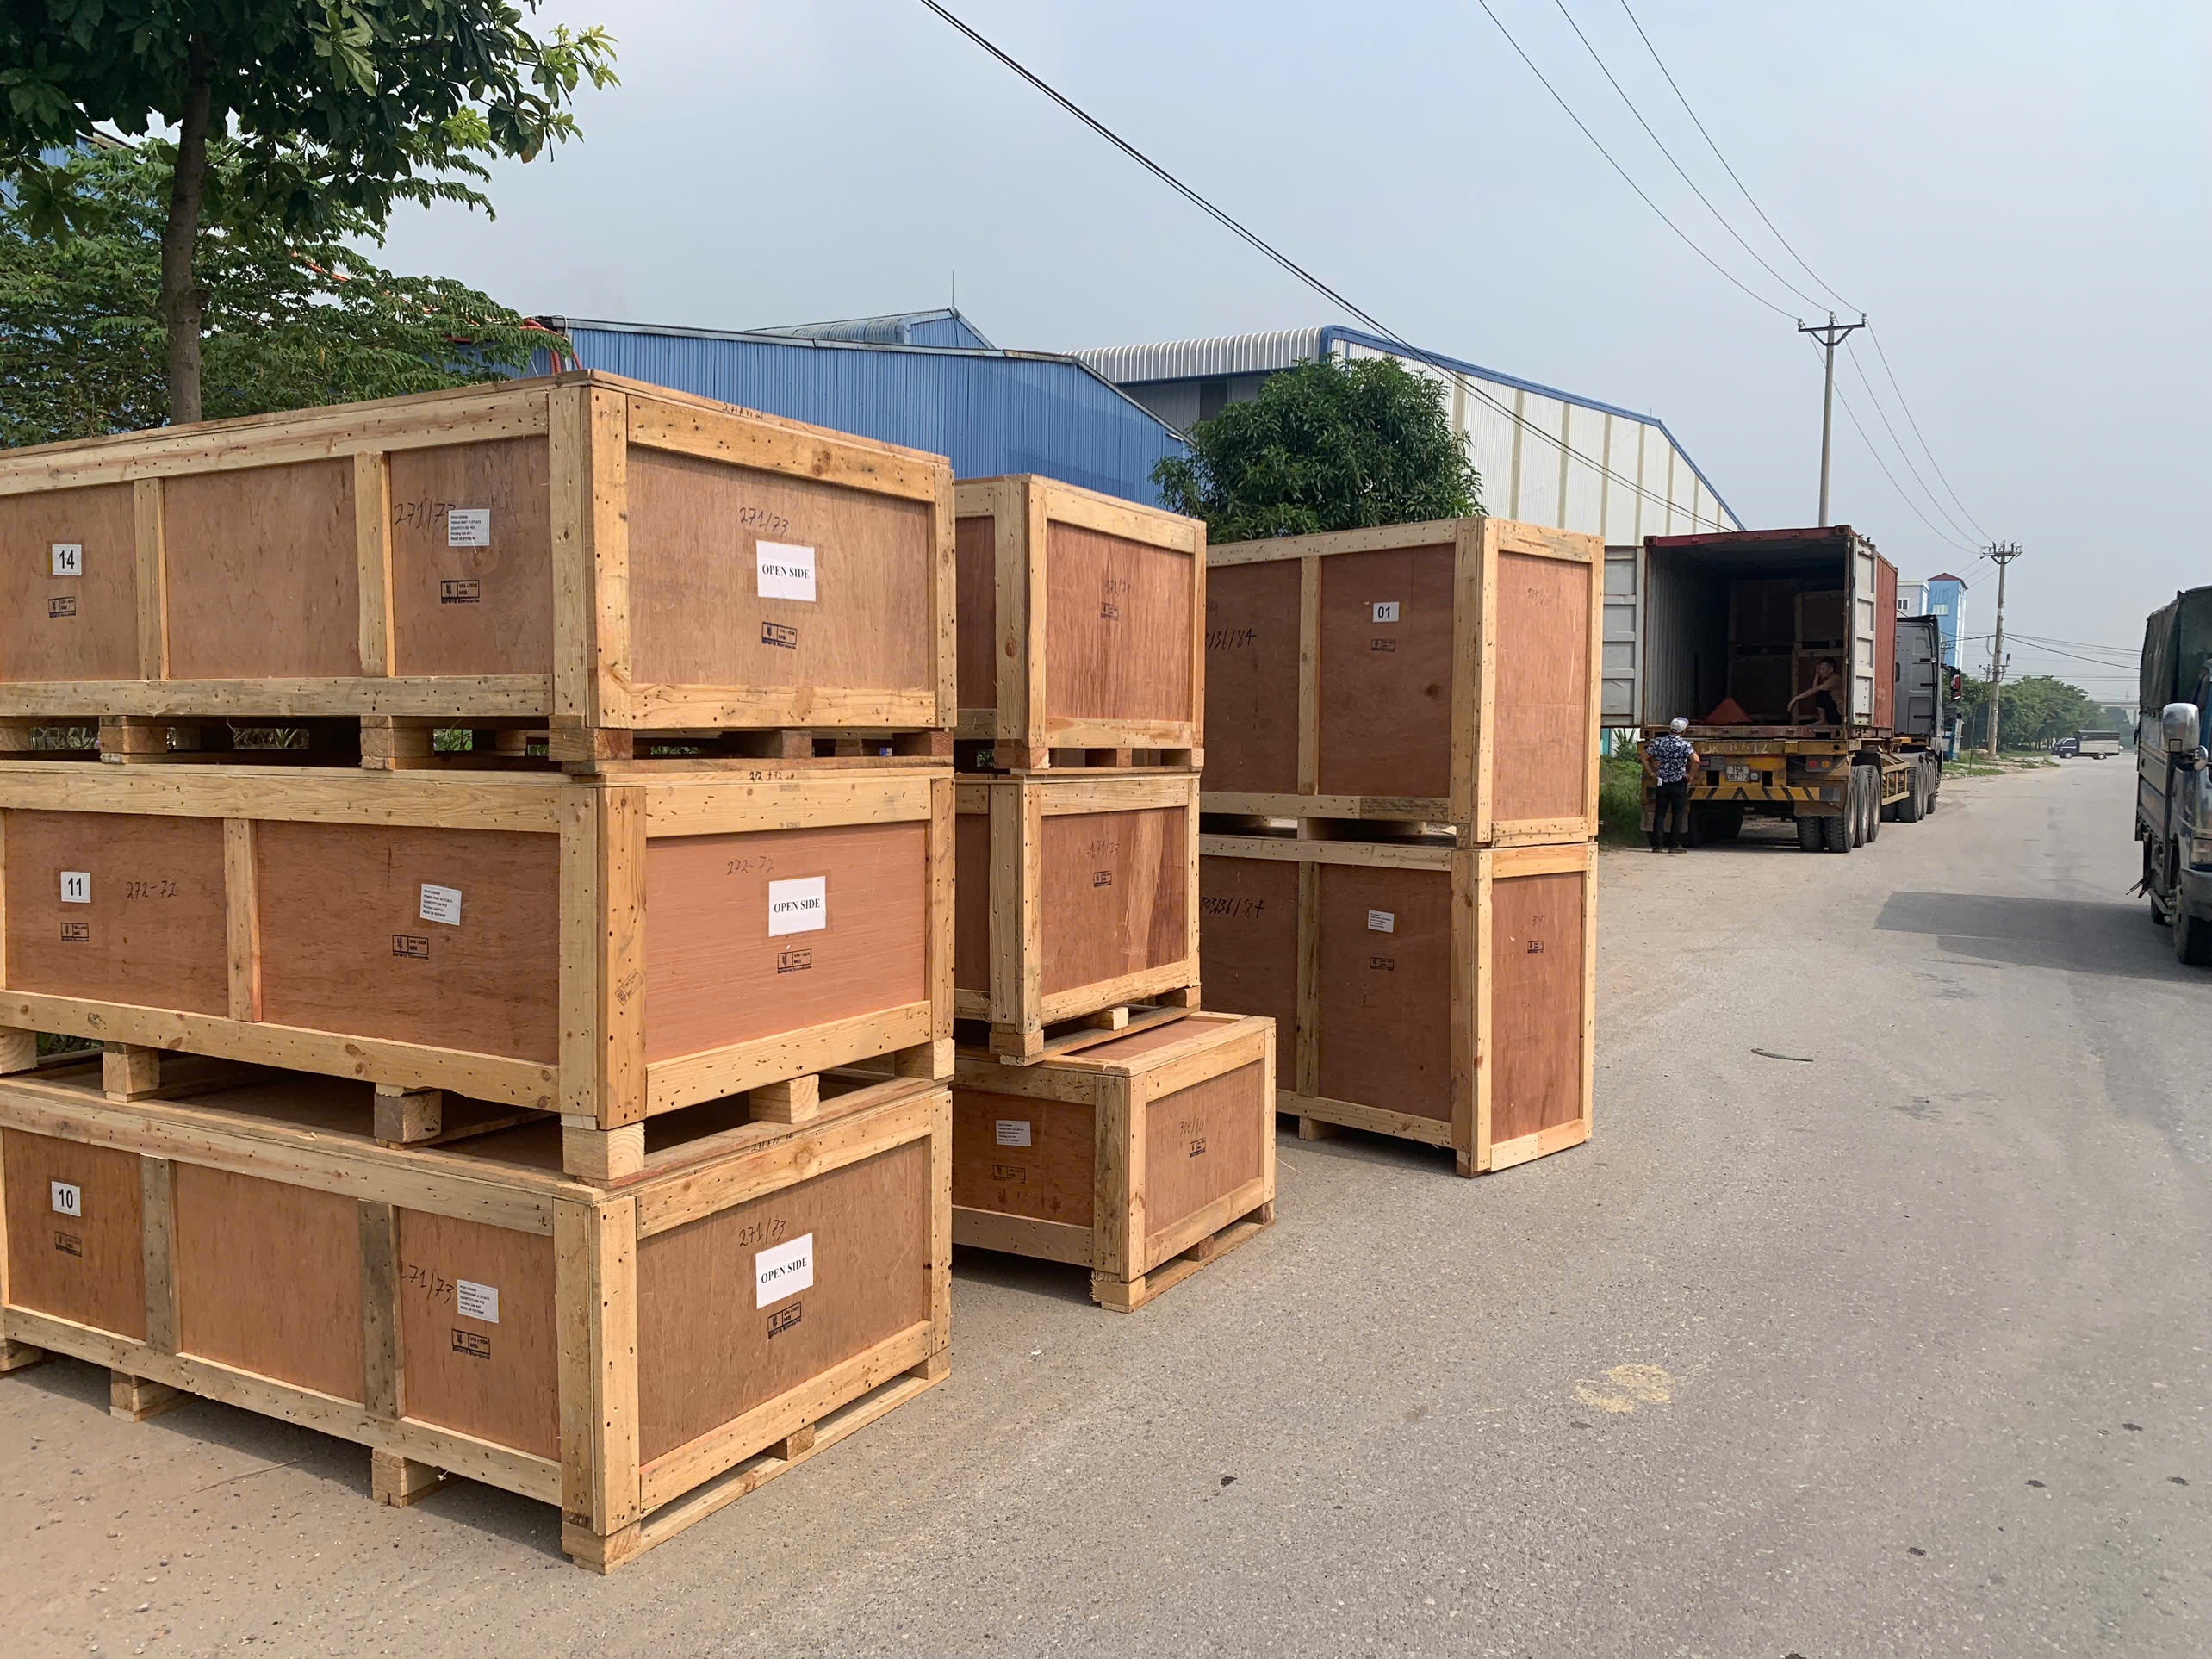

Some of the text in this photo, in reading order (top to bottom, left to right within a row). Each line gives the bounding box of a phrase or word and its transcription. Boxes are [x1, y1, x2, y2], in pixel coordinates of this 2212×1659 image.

[739, 507, 789, 538] 271/73
[59, 550, 75, 569] 14
[761, 564, 810, 579] OPEN SIDE
[1378, 606, 1391, 618] 01
[68, 877, 82, 897] 11
[774, 898, 820, 914] OPEN SIDE
[59, 1188, 73, 1209] 10
[739, 1217, 786, 1247] 271/73
[761, 1257, 807, 1283] OPEN SIDE
